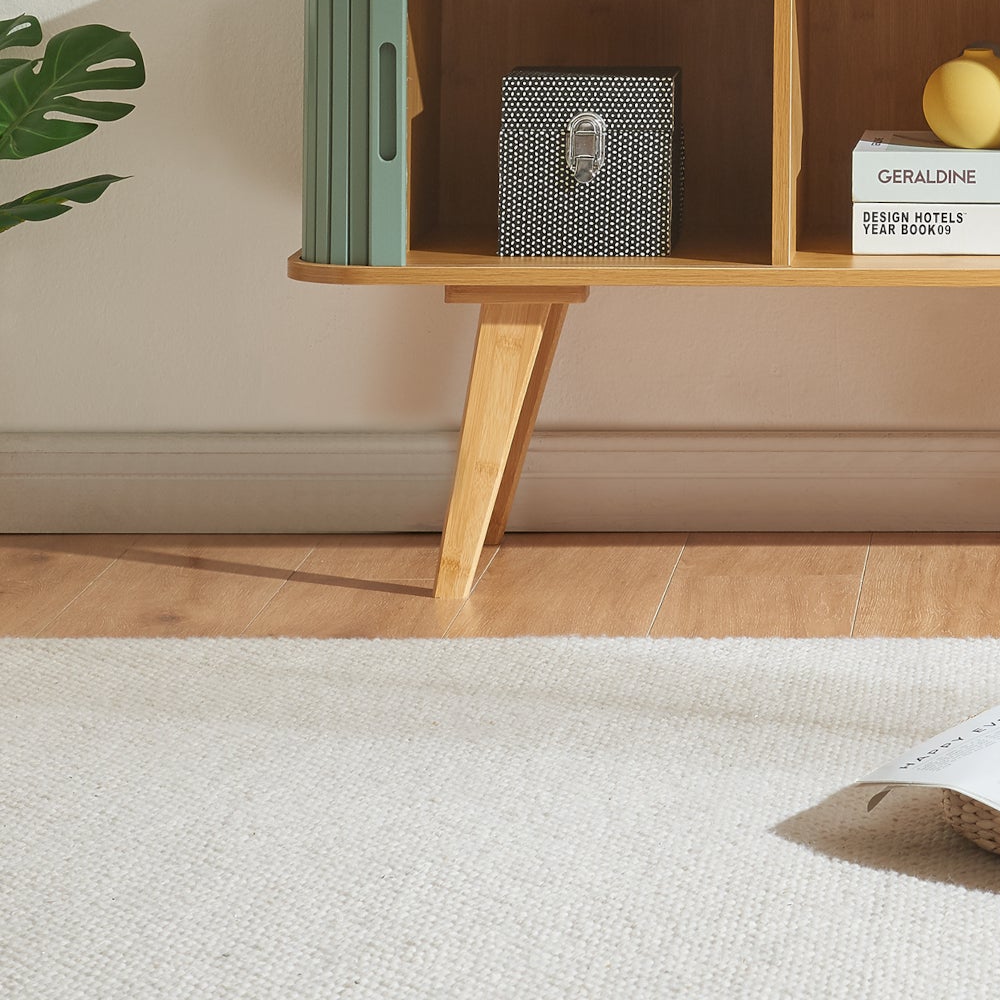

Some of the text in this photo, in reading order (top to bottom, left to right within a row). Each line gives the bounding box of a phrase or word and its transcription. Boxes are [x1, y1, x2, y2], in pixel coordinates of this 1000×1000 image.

[878, 169, 977, 184] GERALDINE
[863, 211, 909, 223] DESIGN
[863, 223, 896, 235] YEAR
[899, 736, 964, 769] HAPPY
